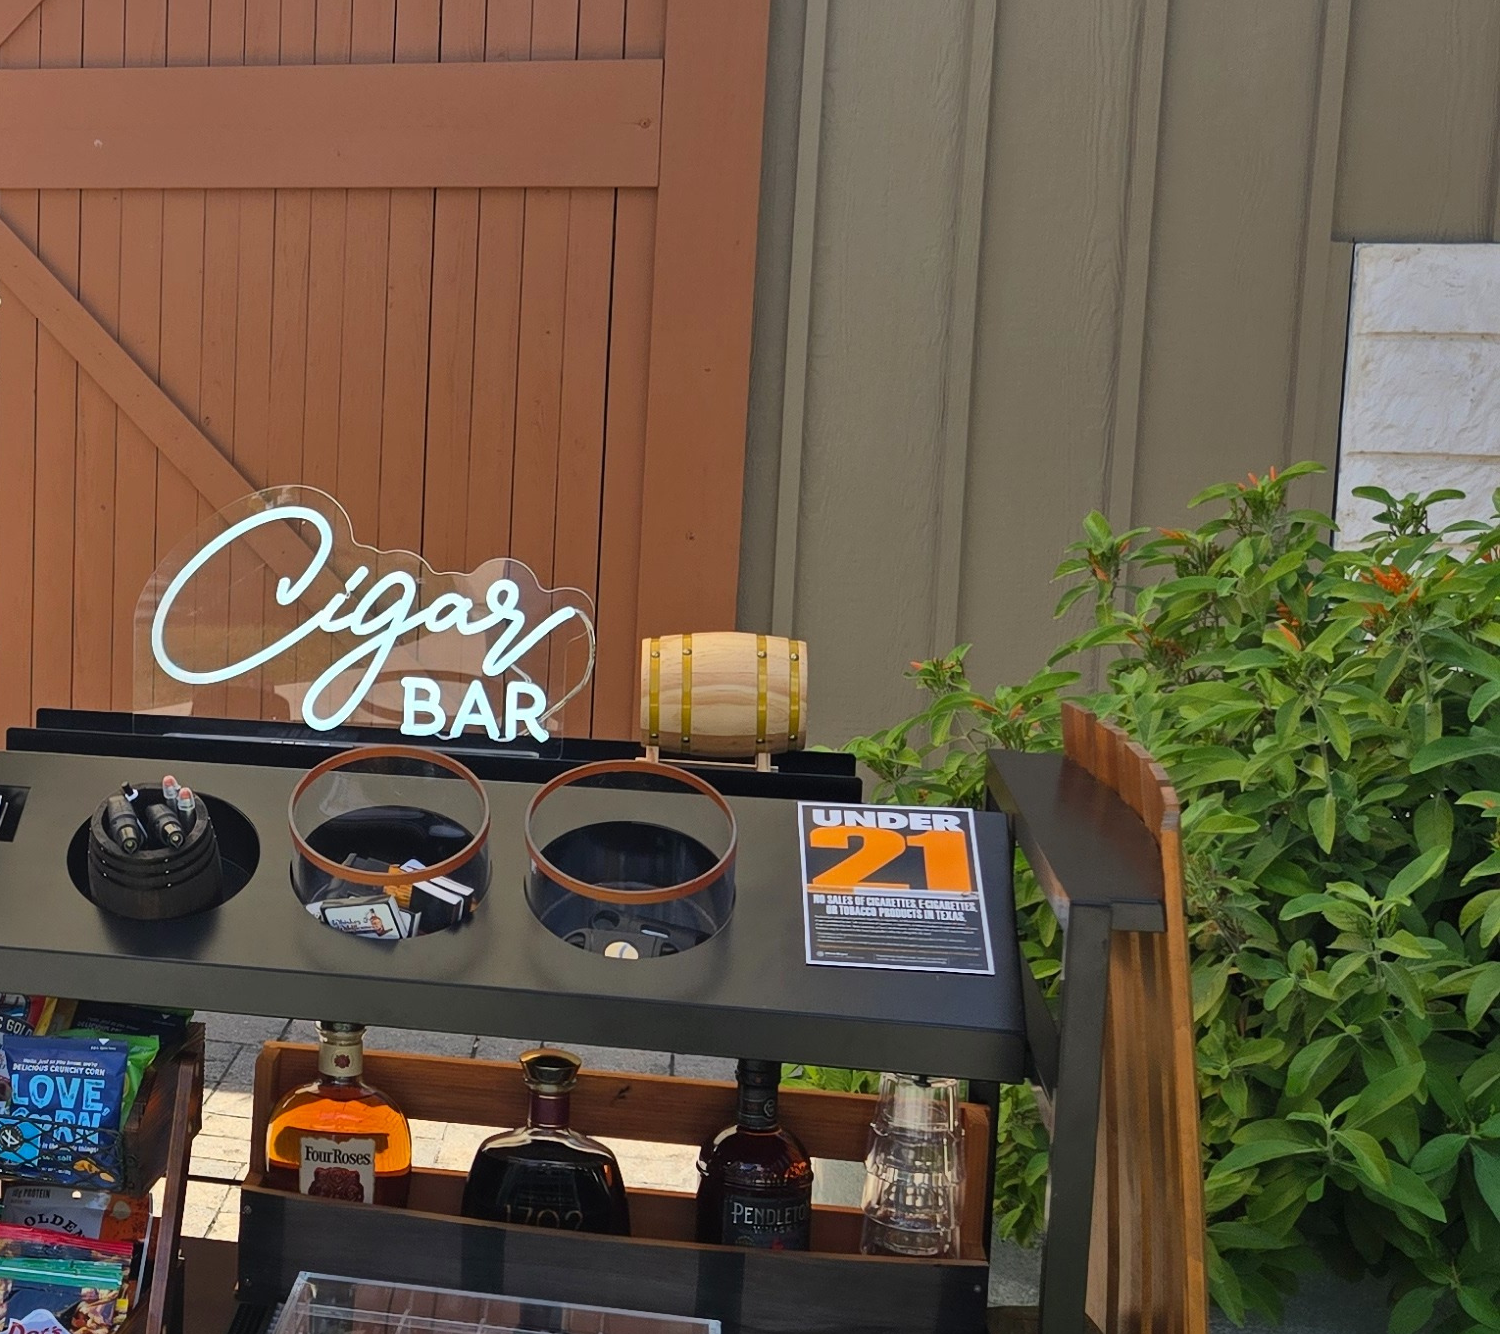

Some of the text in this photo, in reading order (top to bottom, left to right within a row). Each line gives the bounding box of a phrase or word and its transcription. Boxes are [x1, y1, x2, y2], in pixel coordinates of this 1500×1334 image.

[151, 505, 576, 731] Cigar
[400, 676, 550, 743] BAR
[812, 809, 963, 832] UNDER
[809, 826, 972, 892] 21
[813, 894, 826, 904] NO
[827, 895, 853, 906] SALES
[855, 896, 866, 906] OF
[826, 904, 967, 923] OR TOBACCO PRODUCTS IN TEXAS.
[6, 1019, 33, 1036] GOLD
[12, 1063, 49, 1072] DELICIOUS
[49, 1065, 85, 1074] CRUNCHY
[85, 1067, 106, 1076] CORN
[11, 1073, 105, 1111] LOVE
[304, 1145, 371, 1165] Four Roses
[23, 1188, 52, 1199] PROTEIN
